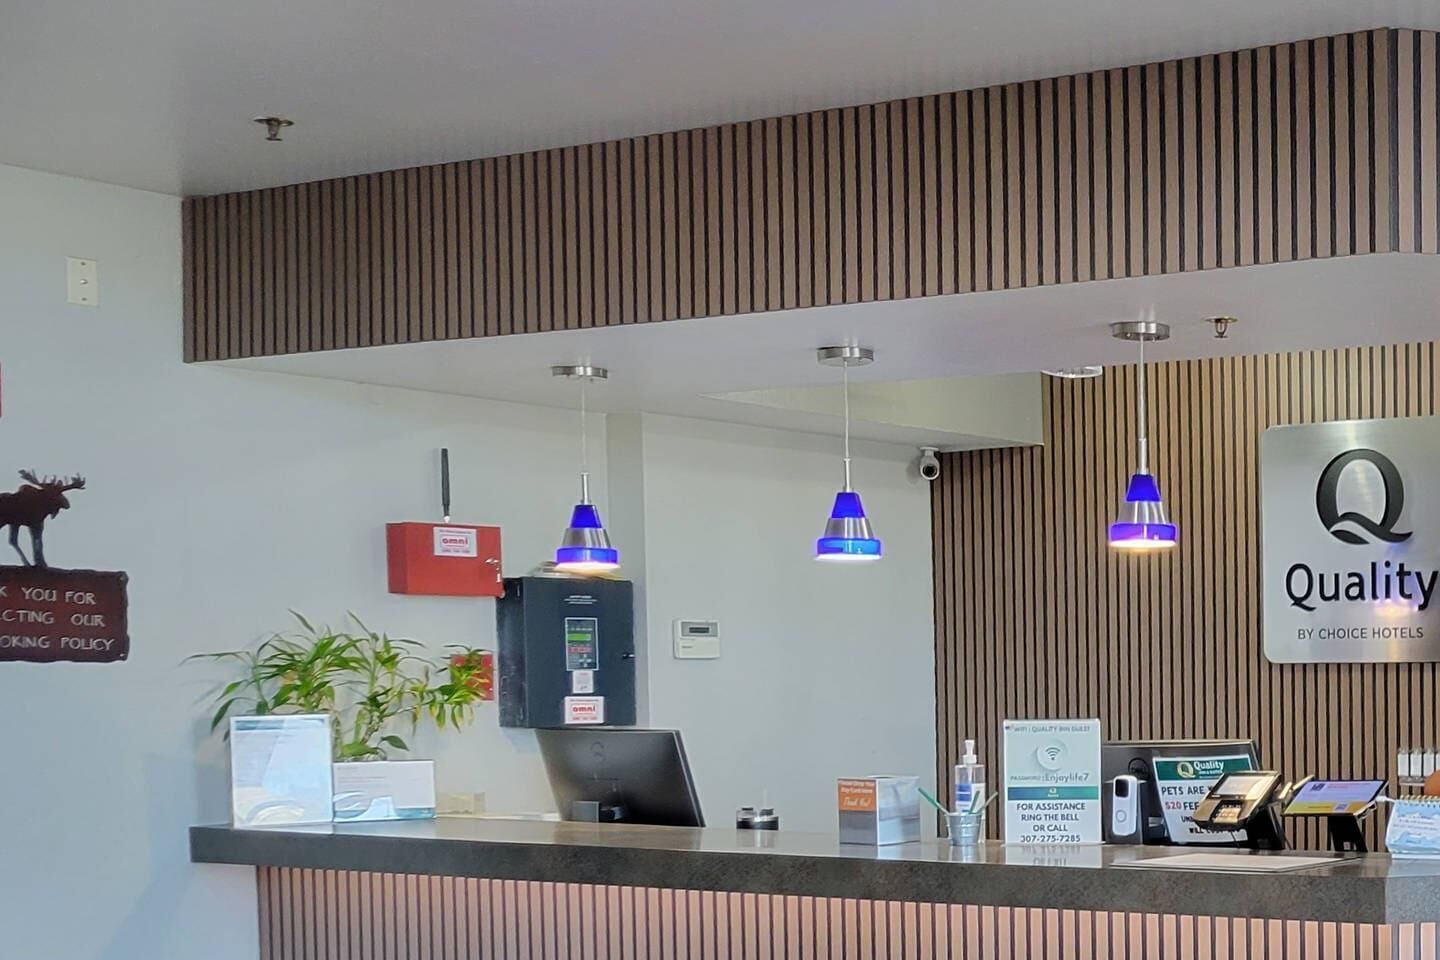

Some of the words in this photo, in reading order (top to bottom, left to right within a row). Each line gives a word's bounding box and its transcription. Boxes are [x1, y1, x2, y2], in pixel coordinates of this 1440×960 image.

[1316, 448, 1413, 545] Q
[1285, 561, 1439, 612] Quality
[21, 586, 57, 602] YOU
[64, 591, 96, 605] FOR
[0, 609, 55, 624] CTING
[70, 613, 106, 627] OUR
[1297, 628, 1314, 640] BY
[1318, 627, 1368, 640] CHOICE
[1372, 626, 1424, 639] HOTELS
[60, 636, 115, 651] POLICY
[573, 703, 596, 712] omni
[1194, 760, 1224, 771] Quality
[1161, 786, 1184, 795] PETS
[1187, 786, 1206, 795] ARE
[1060, 813, 1080, 821] BELL
[1032, 824, 1045, 832] OR
[1047, 824, 1068, 832] CALL
